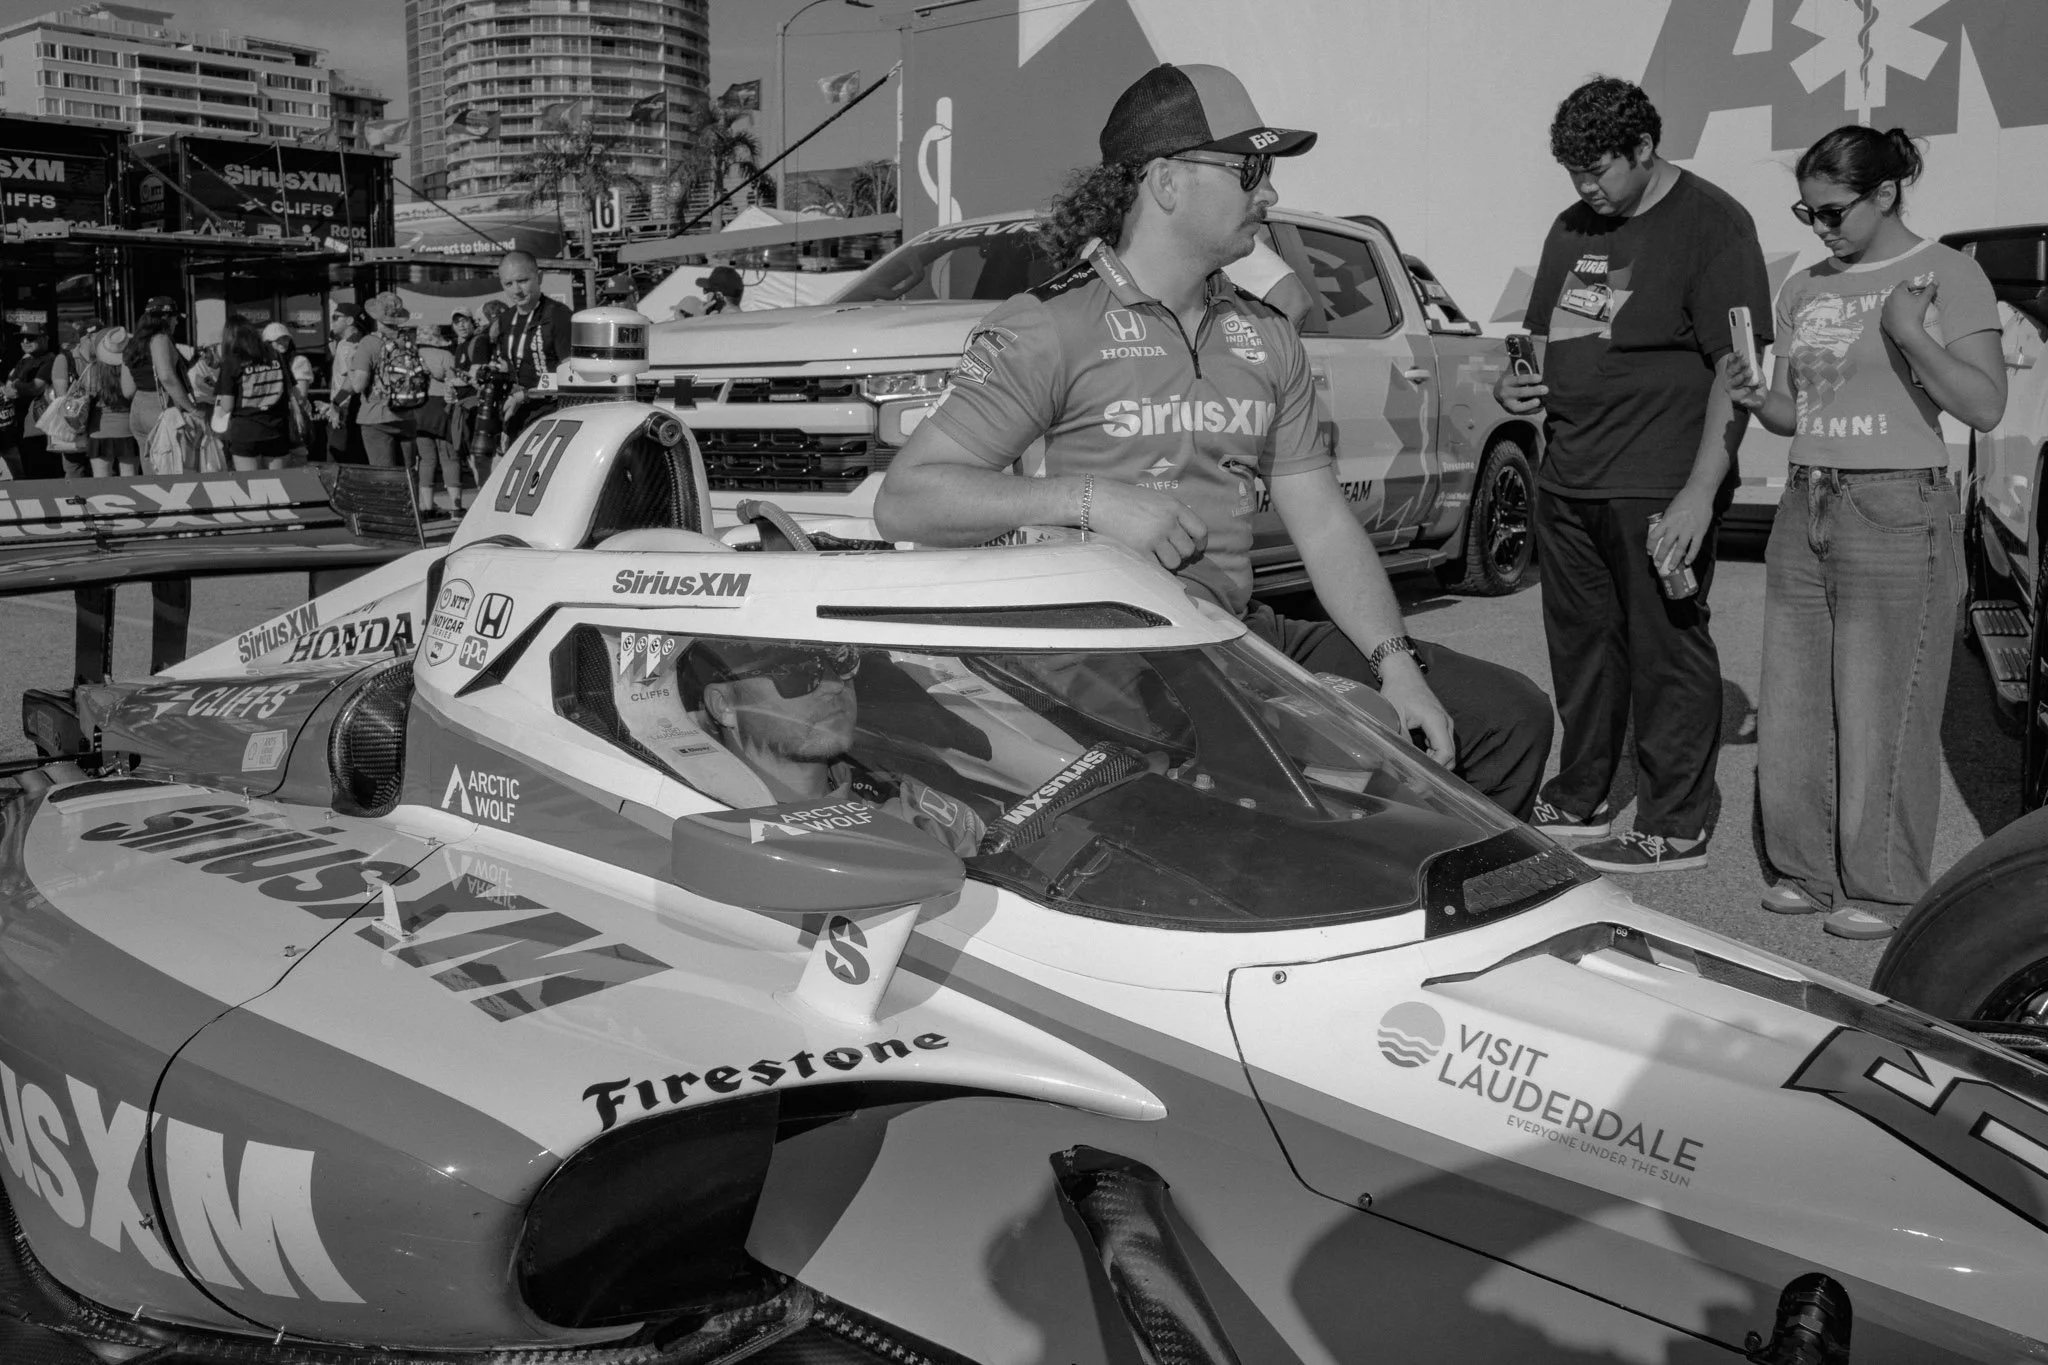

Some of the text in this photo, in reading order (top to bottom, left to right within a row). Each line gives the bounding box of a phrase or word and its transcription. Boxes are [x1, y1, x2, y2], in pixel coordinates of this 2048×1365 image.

[1248, 131, 1280, 150] 66
[224, 164, 341, 193] SiriusXM
[271, 200, 334, 217] CLIFFS
[330, 224, 367, 239] Root
[1100, 346, 1164, 360] HONDA
[612, 569, 751, 597] SiriusXM
[237, 601, 319, 664] SiriusXM
[282, 611, 416, 665] HONDA
[187, 683, 300, 720] CLIFFS
[630, 688, 670, 702] CLIFFS
[468, 770, 520, 801] ARCTIC
[1003, 750, 1107, 825] SiriusXM
[475, 796, 516, 824] WOLF
[780, 802, 869, 824] ARCTIC
[803, 812, 873, 833] WOLF
[80, 804, 674, 1023] SiriusXM
[1460, 1023, 1549, 1077] VISIT
[582, 1031, 946, 1132] Firestone
[1438, 1052, 1705, 1172] LAUDERDALE
[1506, 1113, 1692, 1189] EVERYONE UNDER THE SUN
